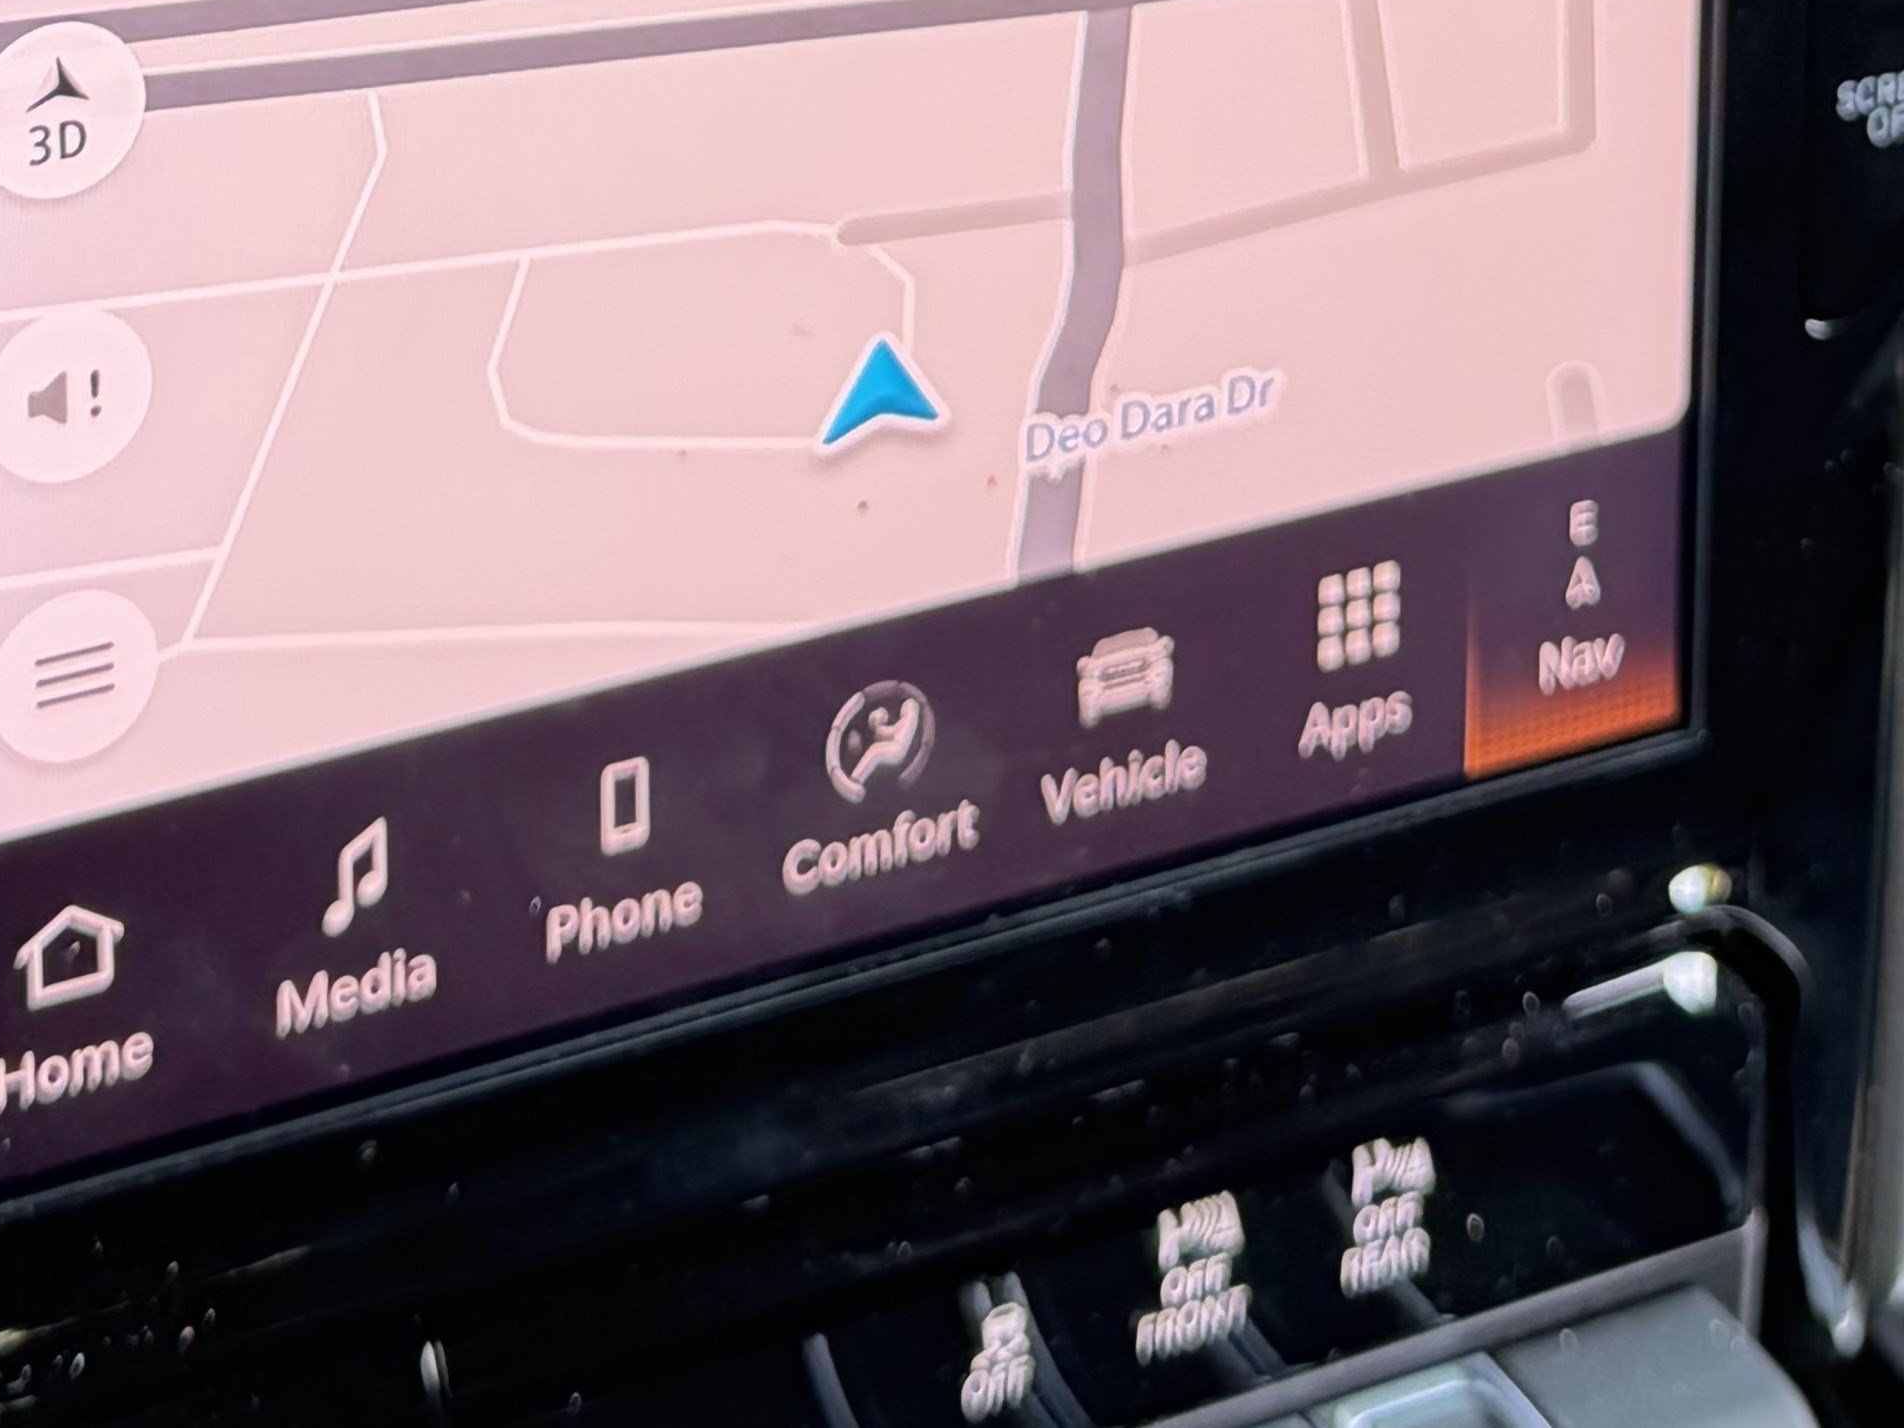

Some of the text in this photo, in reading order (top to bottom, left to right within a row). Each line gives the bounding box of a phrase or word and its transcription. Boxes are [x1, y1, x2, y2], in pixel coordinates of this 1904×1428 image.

[29, 120, 87, 166] 3D
[1026, 376, 1277, 463] Deo Dara Dr
[1538, 631, 1626, 695] Nav
[1299, 690, 1414, 759] Apps
[1041, 740, 1208, 825] Vehicle
[782, 799, 980, 896] Comfort
[545, 881, 703, 963] Phone
[275, 948, 437, 1038] Media
